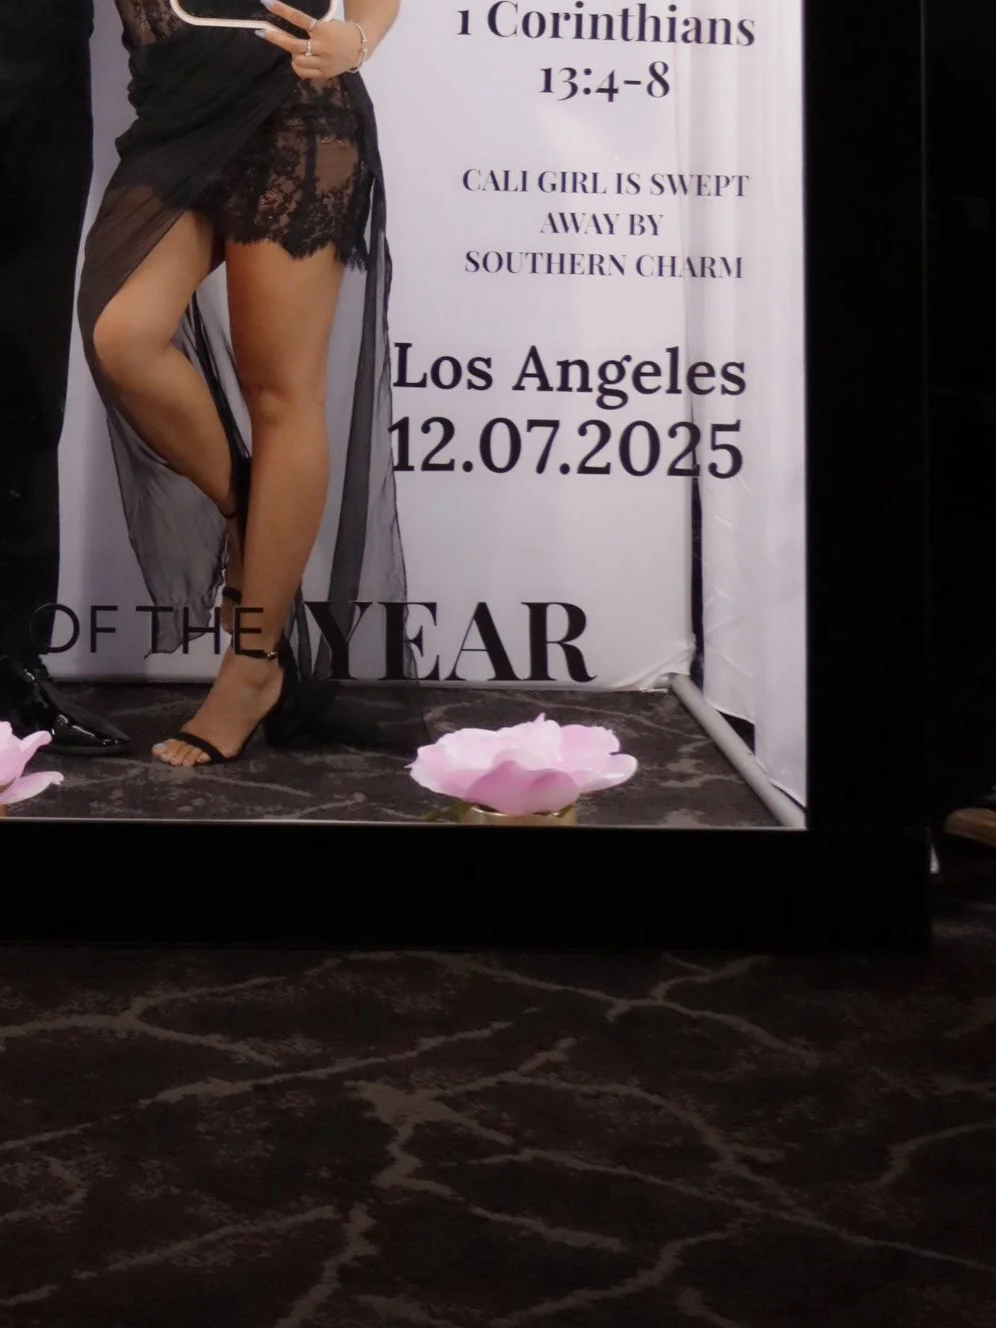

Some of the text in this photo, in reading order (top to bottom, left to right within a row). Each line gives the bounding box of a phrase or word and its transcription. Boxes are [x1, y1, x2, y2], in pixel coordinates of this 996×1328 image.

[455, 0, 756, 47] 1 Corinthians
[538, 60, 671, 103] 13:4-8
[461, 168, 751, 198] CALI GIRL IS SWEPT
[539, 212, 665, 237] AWAY BY
[463, 250, 744, 280] SOUTHERN CHARM
[392, 342, 747, 410] Los Angeles
[387, 415, 744, 480] 12.07.2025
[28, 602, 119, 655] OF
[135, 605, 265, 656] THE
[303, 600, 598, 683] YEAR
